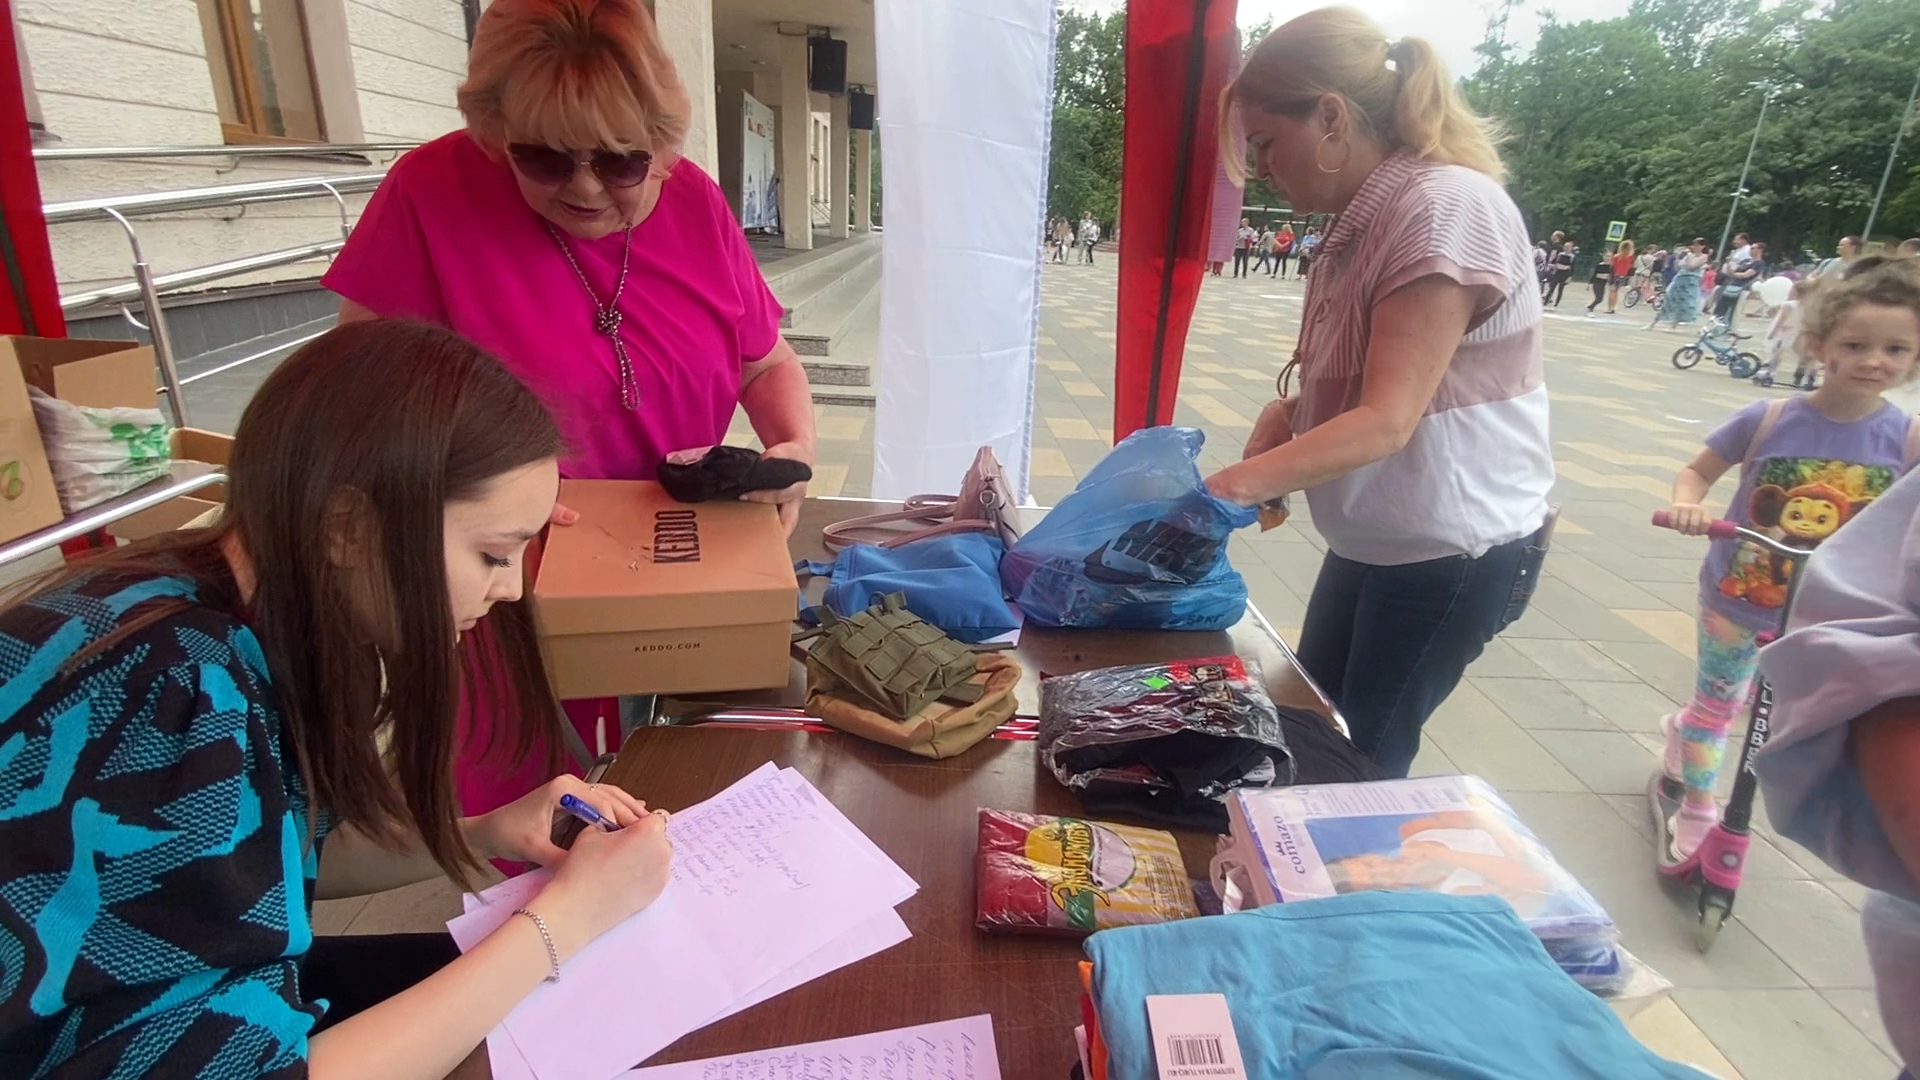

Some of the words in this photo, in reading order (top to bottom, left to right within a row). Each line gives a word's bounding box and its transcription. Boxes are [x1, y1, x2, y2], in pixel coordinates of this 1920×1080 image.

[653, 510, 701, 564] KEDDO
[634, 642, 701, 653] KEDDO.COM
[1274, 815, 1306, 875] comazo
